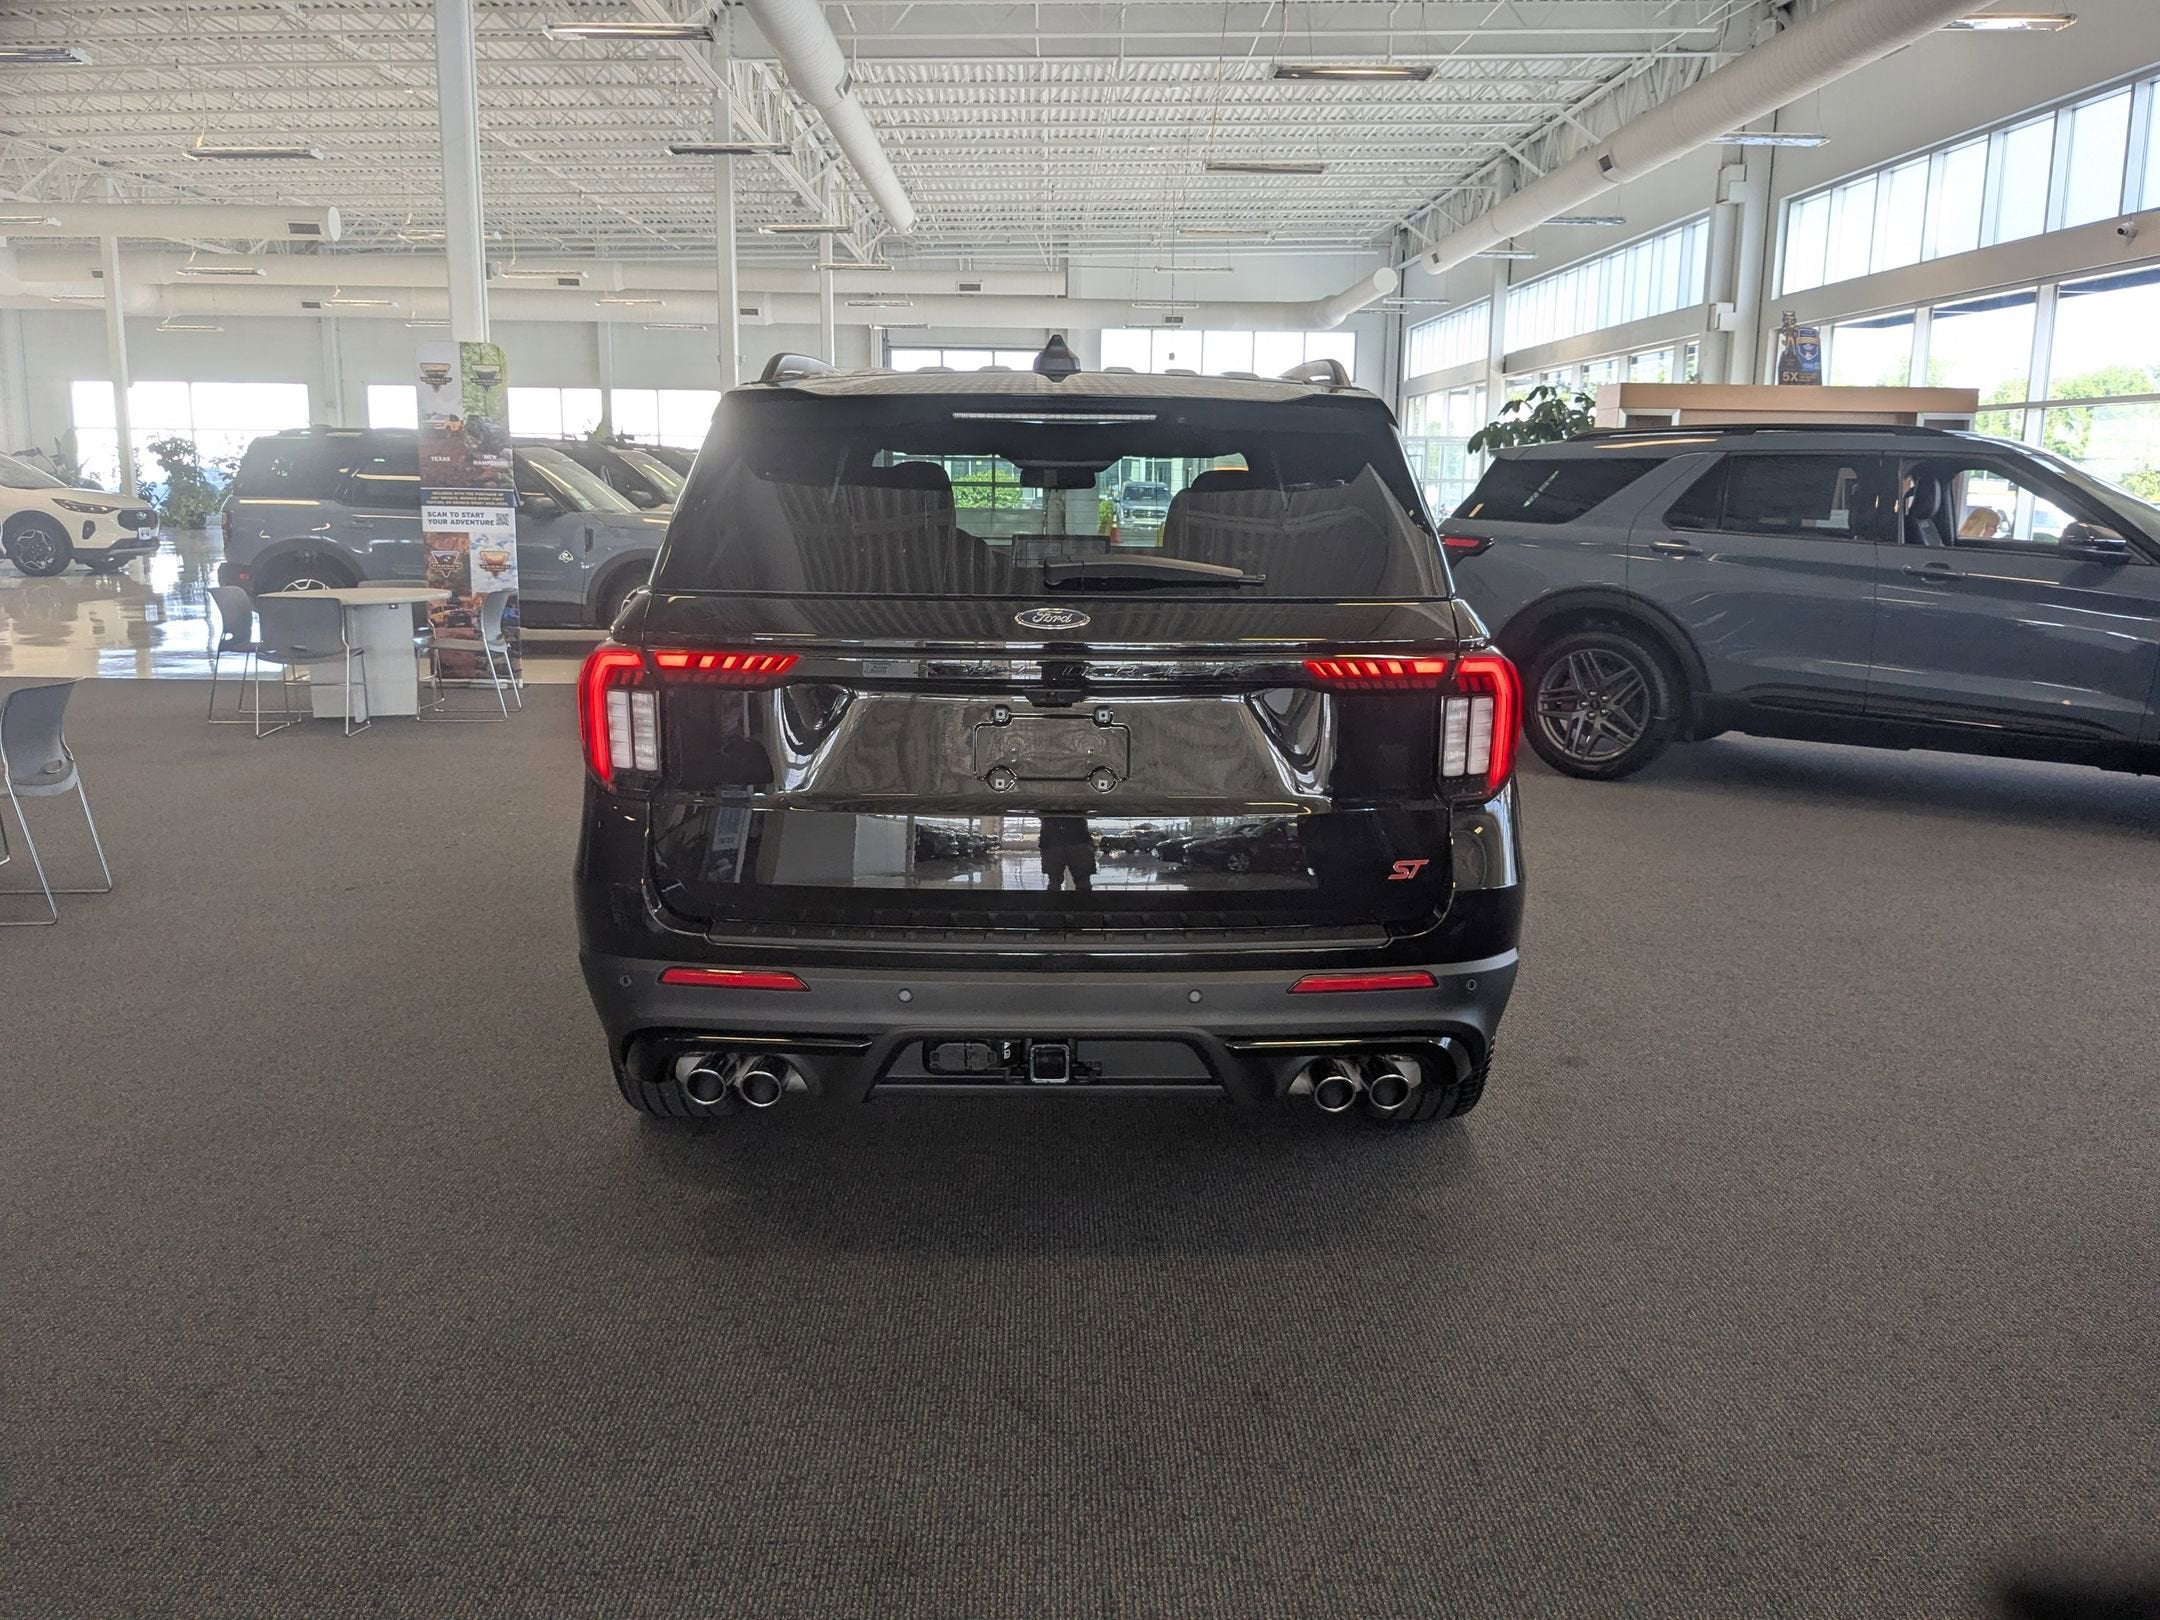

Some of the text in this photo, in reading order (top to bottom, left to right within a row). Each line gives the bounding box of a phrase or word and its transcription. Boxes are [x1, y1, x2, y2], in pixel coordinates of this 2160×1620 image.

[1783, 371, 1798, 382] 5X
[1032, 610, 1073, 623] Ford
[1388, 859, 1430, 880] ST
